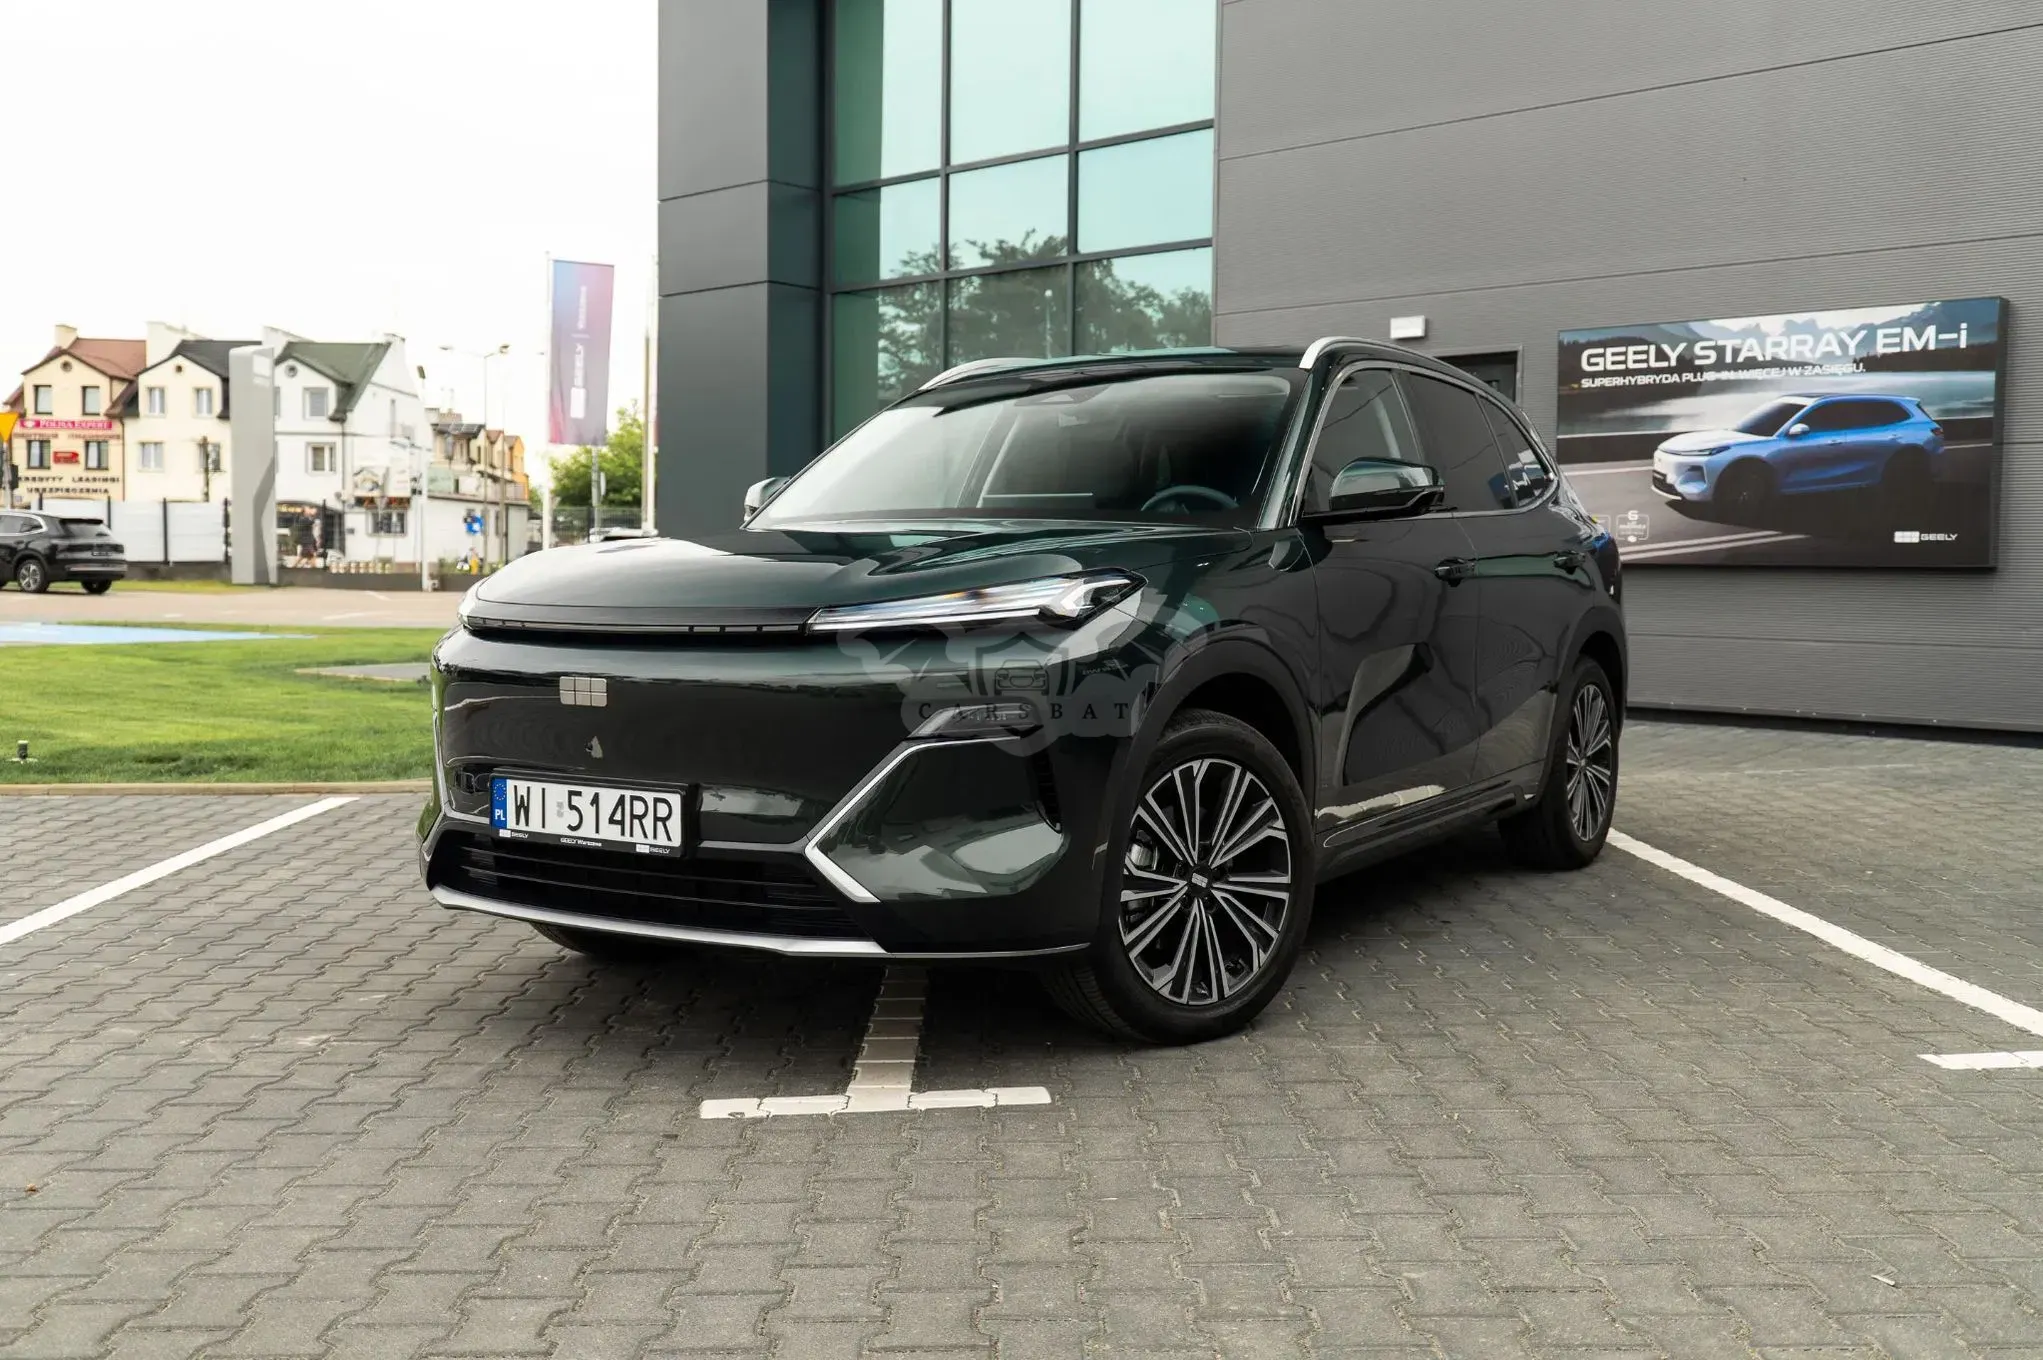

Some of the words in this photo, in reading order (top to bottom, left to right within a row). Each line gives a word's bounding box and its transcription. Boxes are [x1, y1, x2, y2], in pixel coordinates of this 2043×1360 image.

[1580, 343, 1688, 372] GEELY
[1693, 330, 1868, 366] STARRAY
[1876, 322, 1968, 353] EM-i
[1580, 374, 1680, 389] SUPERHYBRYDA
[1787, 366, 1800, 376] W
[1920, 533, 1958, 541] GEELY
[494, 808, 506, 821] PL
[513, 784, 547, 829] WI
[566, 789, 673, 842] 514RR
